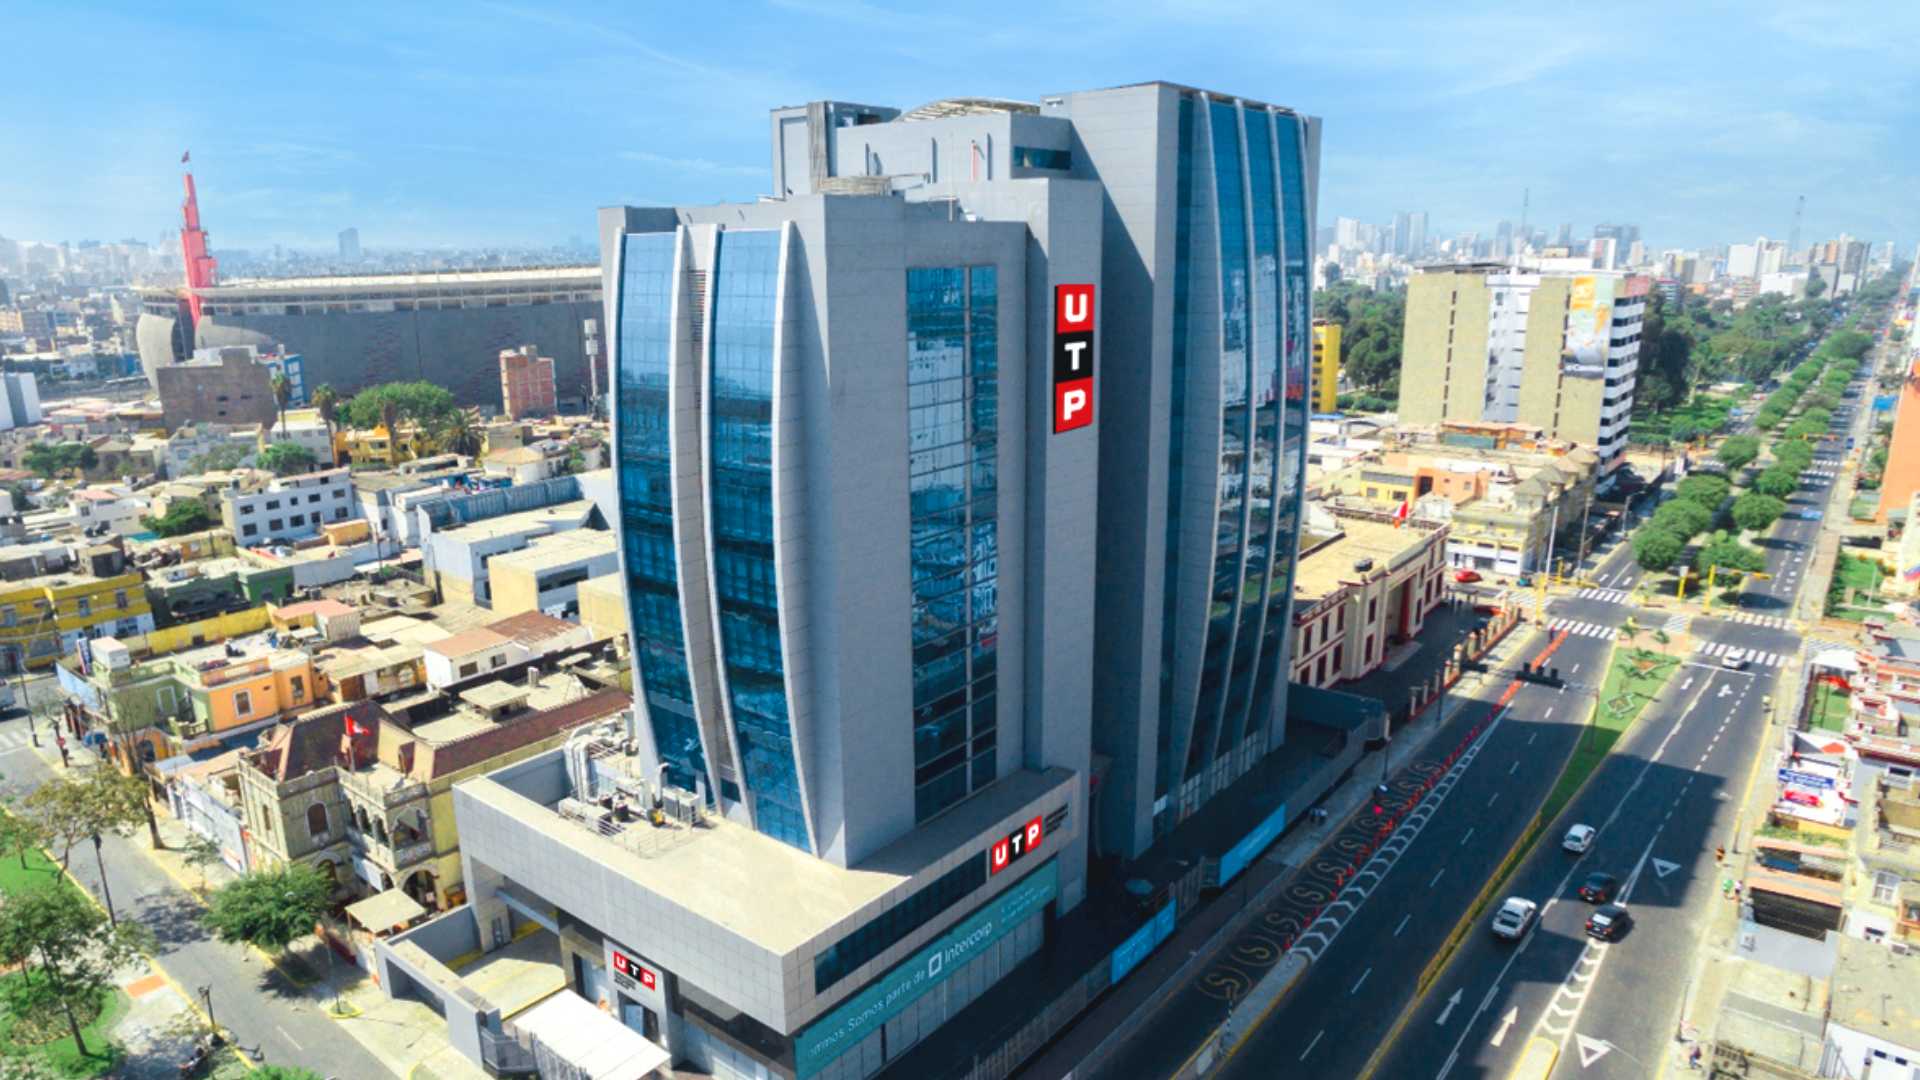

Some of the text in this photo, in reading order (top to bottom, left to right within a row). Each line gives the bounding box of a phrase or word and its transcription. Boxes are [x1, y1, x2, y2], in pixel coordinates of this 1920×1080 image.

[1063, 293, 1088, 421] UTP
[995, 823, 1040, 866] UTP
[616, 956, 654, 983] UTP
[847, 1000, 884, 1032] Somos
[944, 921, 993, 964] Intercorp
